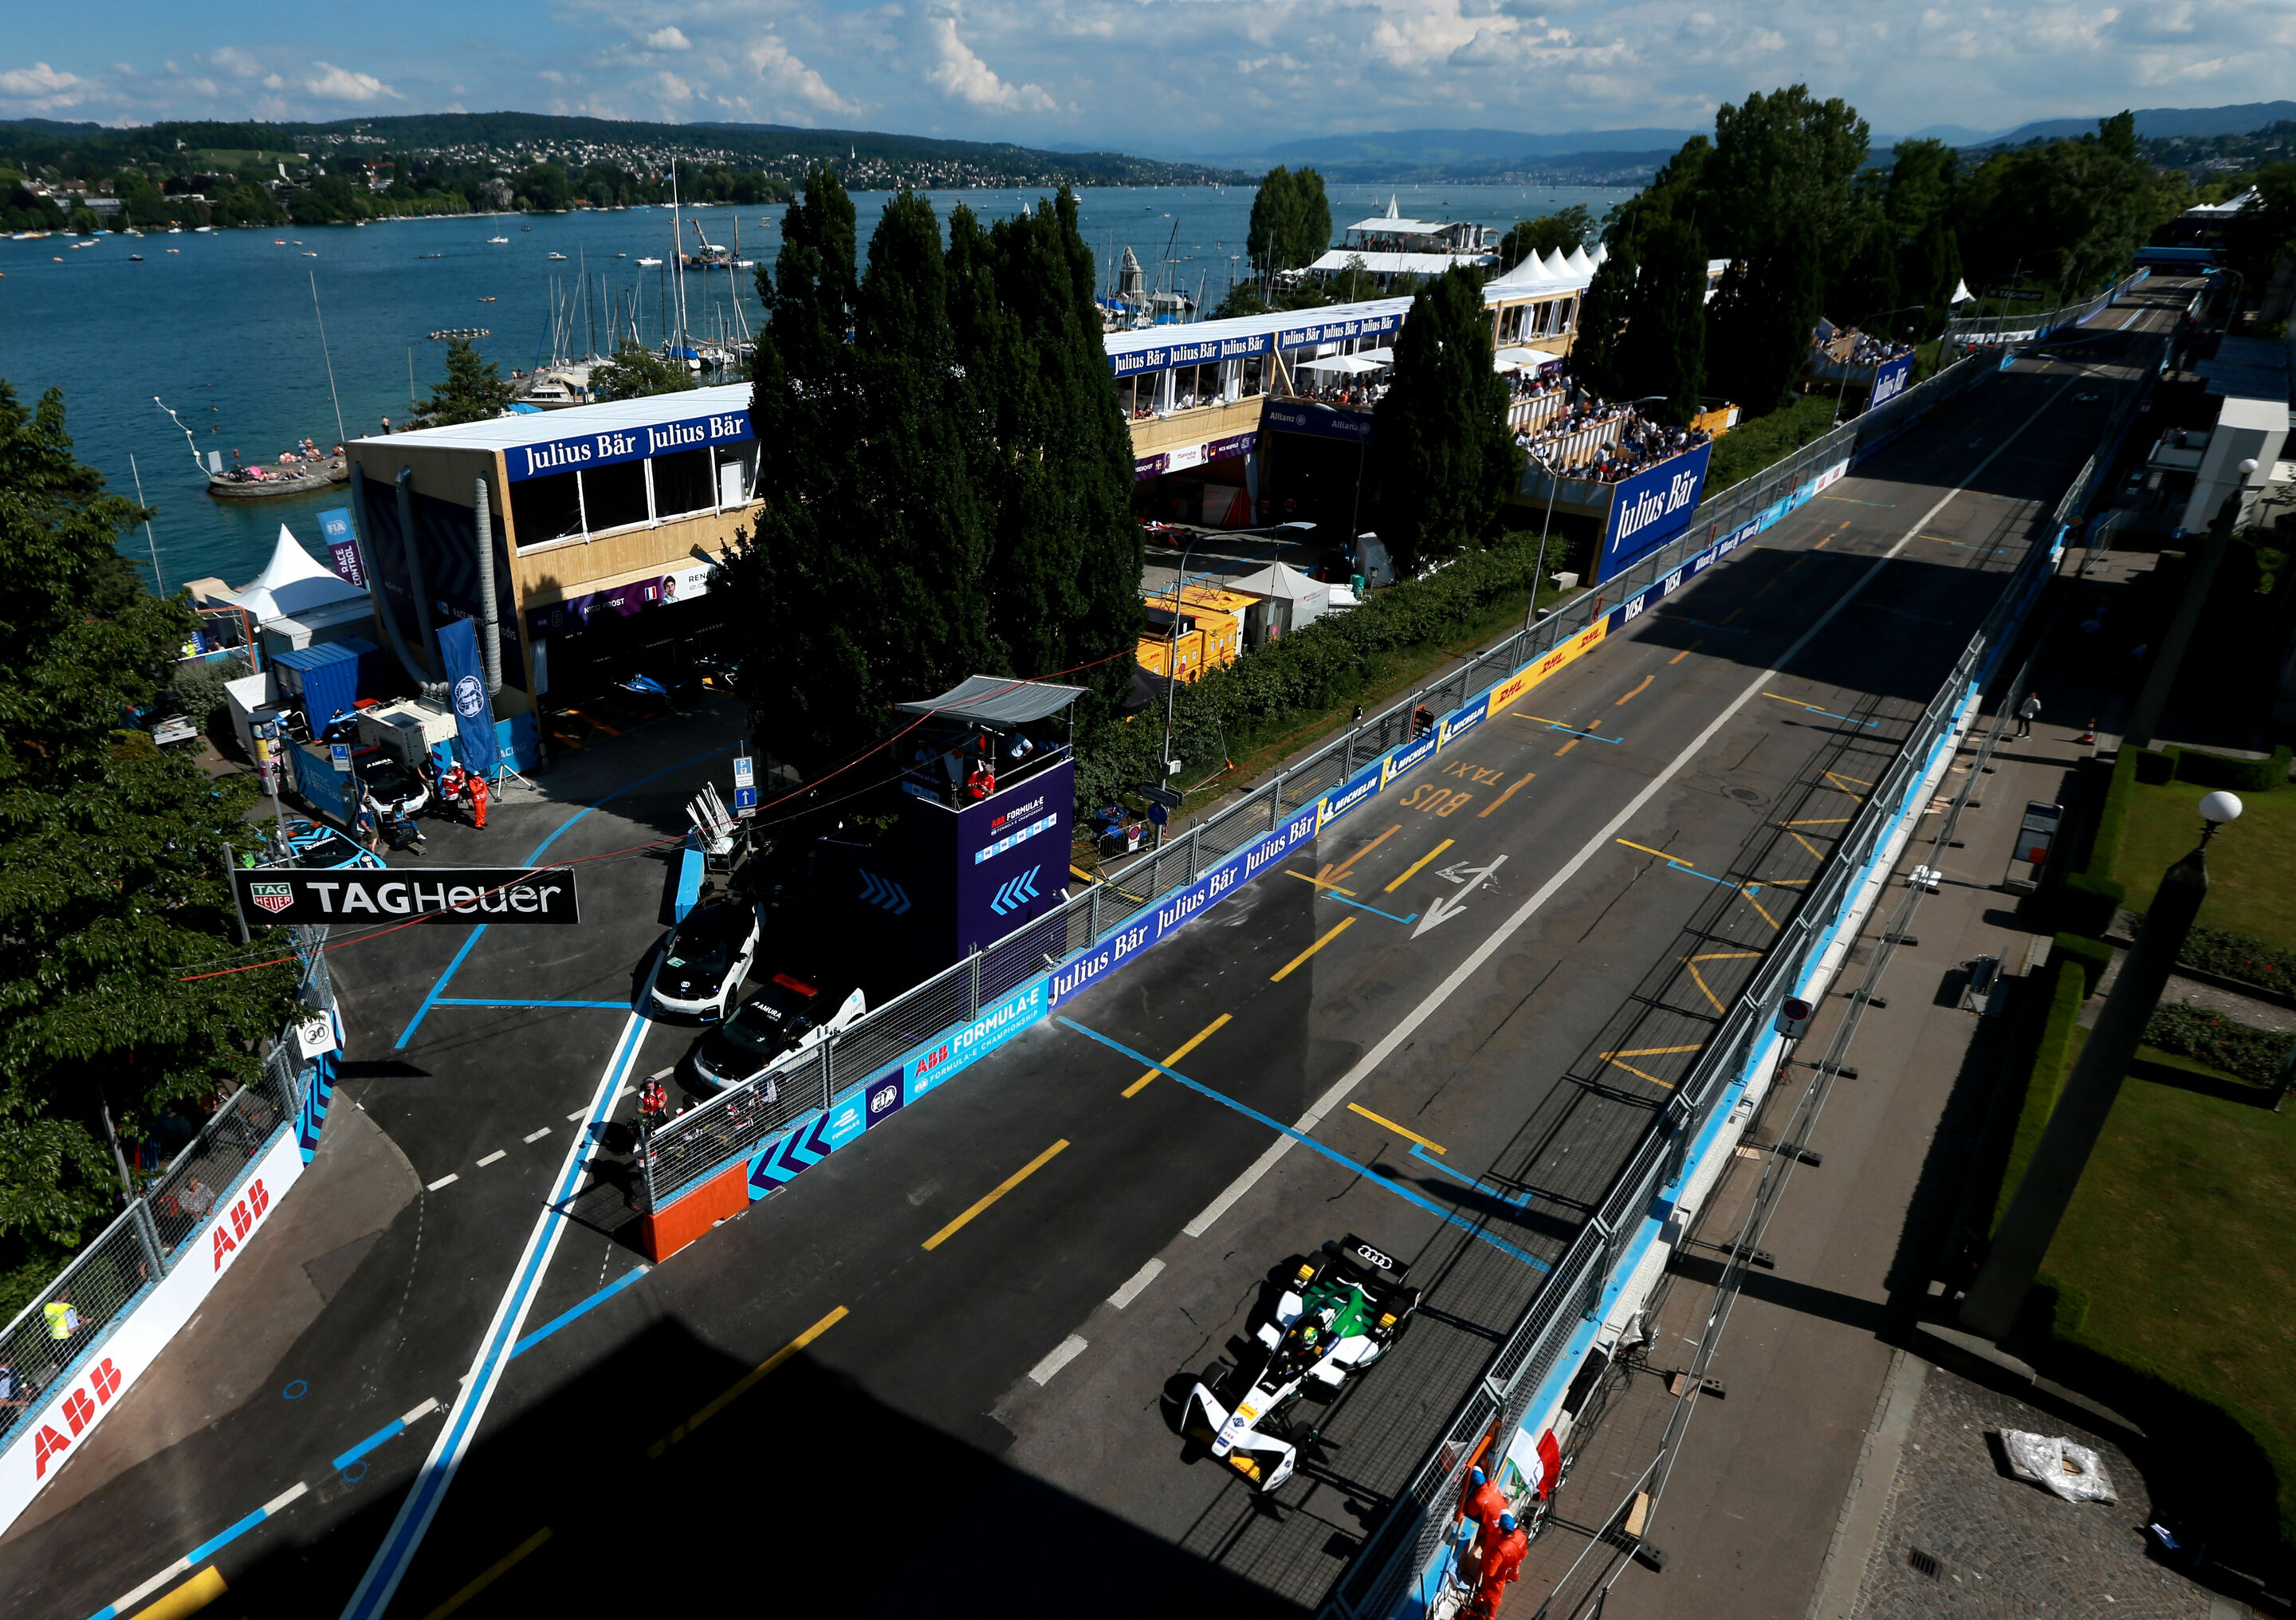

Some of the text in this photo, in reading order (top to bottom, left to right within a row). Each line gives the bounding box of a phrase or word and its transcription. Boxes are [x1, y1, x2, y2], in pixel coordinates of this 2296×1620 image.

[1281, 327, 1320, 345] Julius Bär
[1322, 323, 1359, 343] Julius Bär
[1361, 317, 1394, 336] Julius Bär
[1169, 343, 1217, 367] Julius Bär
[1220, 336, 1264, 359] Julius Bär
[1115, 350, 1166, 376] Julius Bär
[1269, 411, 1295, 423] Allianz
[1331, 420, 1358, 431] Allianz
[647, 415, 745, 454] Julius Bär
[525, 433, 636, 476] Julius Bär
[1612, 470, 1698, 554] Julius Bär
[326, 520, 346, 535] FIA
[336, 548, 348, 573] RACE
[344, 545, 363, 586] CONTROL
[1664, 569, 1683, 596] VISA
[584, 598, 625, 615] NICO PROST
[1625, 594, 1645, 623] VISA
[1580, 628, 1600, 648] DHL
[1541, 652, 1563, 674] DHL
[1498, 679, 1523, 703] DHL
[1452, 705, 1486, 733] MICHELIN
[501, 742, 527, 757] ACING
[1398, 738, 1436, 769] MICHELIN
[1441, 761, 1504, 786] TAXI
[1335, 776, 1378, 812] MICHELIN
[1399, 784, 1473, 818] BUS
[305, 836, 337, 851] Qualcomm
[1244, 816, 1315, 879] Julius Bär
[254, 885, 289, 895] TAG
[256, 895, 293, 906] HEUER
[1156, 866, 1238, 938] Julius Bär
[1052, 925, 1149, 1006] Julius Bär
[757, 1004, 782, 1020] AMURA
[309, 1025, 327, 1043] 30
[930, 1048, 977, 1083] FORMULA-E
[981, 1009, 1039, 1050] CHAMPIONSHIP
[915, 1044, 949, 1078] ABB
[871, 1086, 897, 1113] FIA
[214, 1178, 270, 1274] ABB
[35, 1358, 122, 1481] ABB
